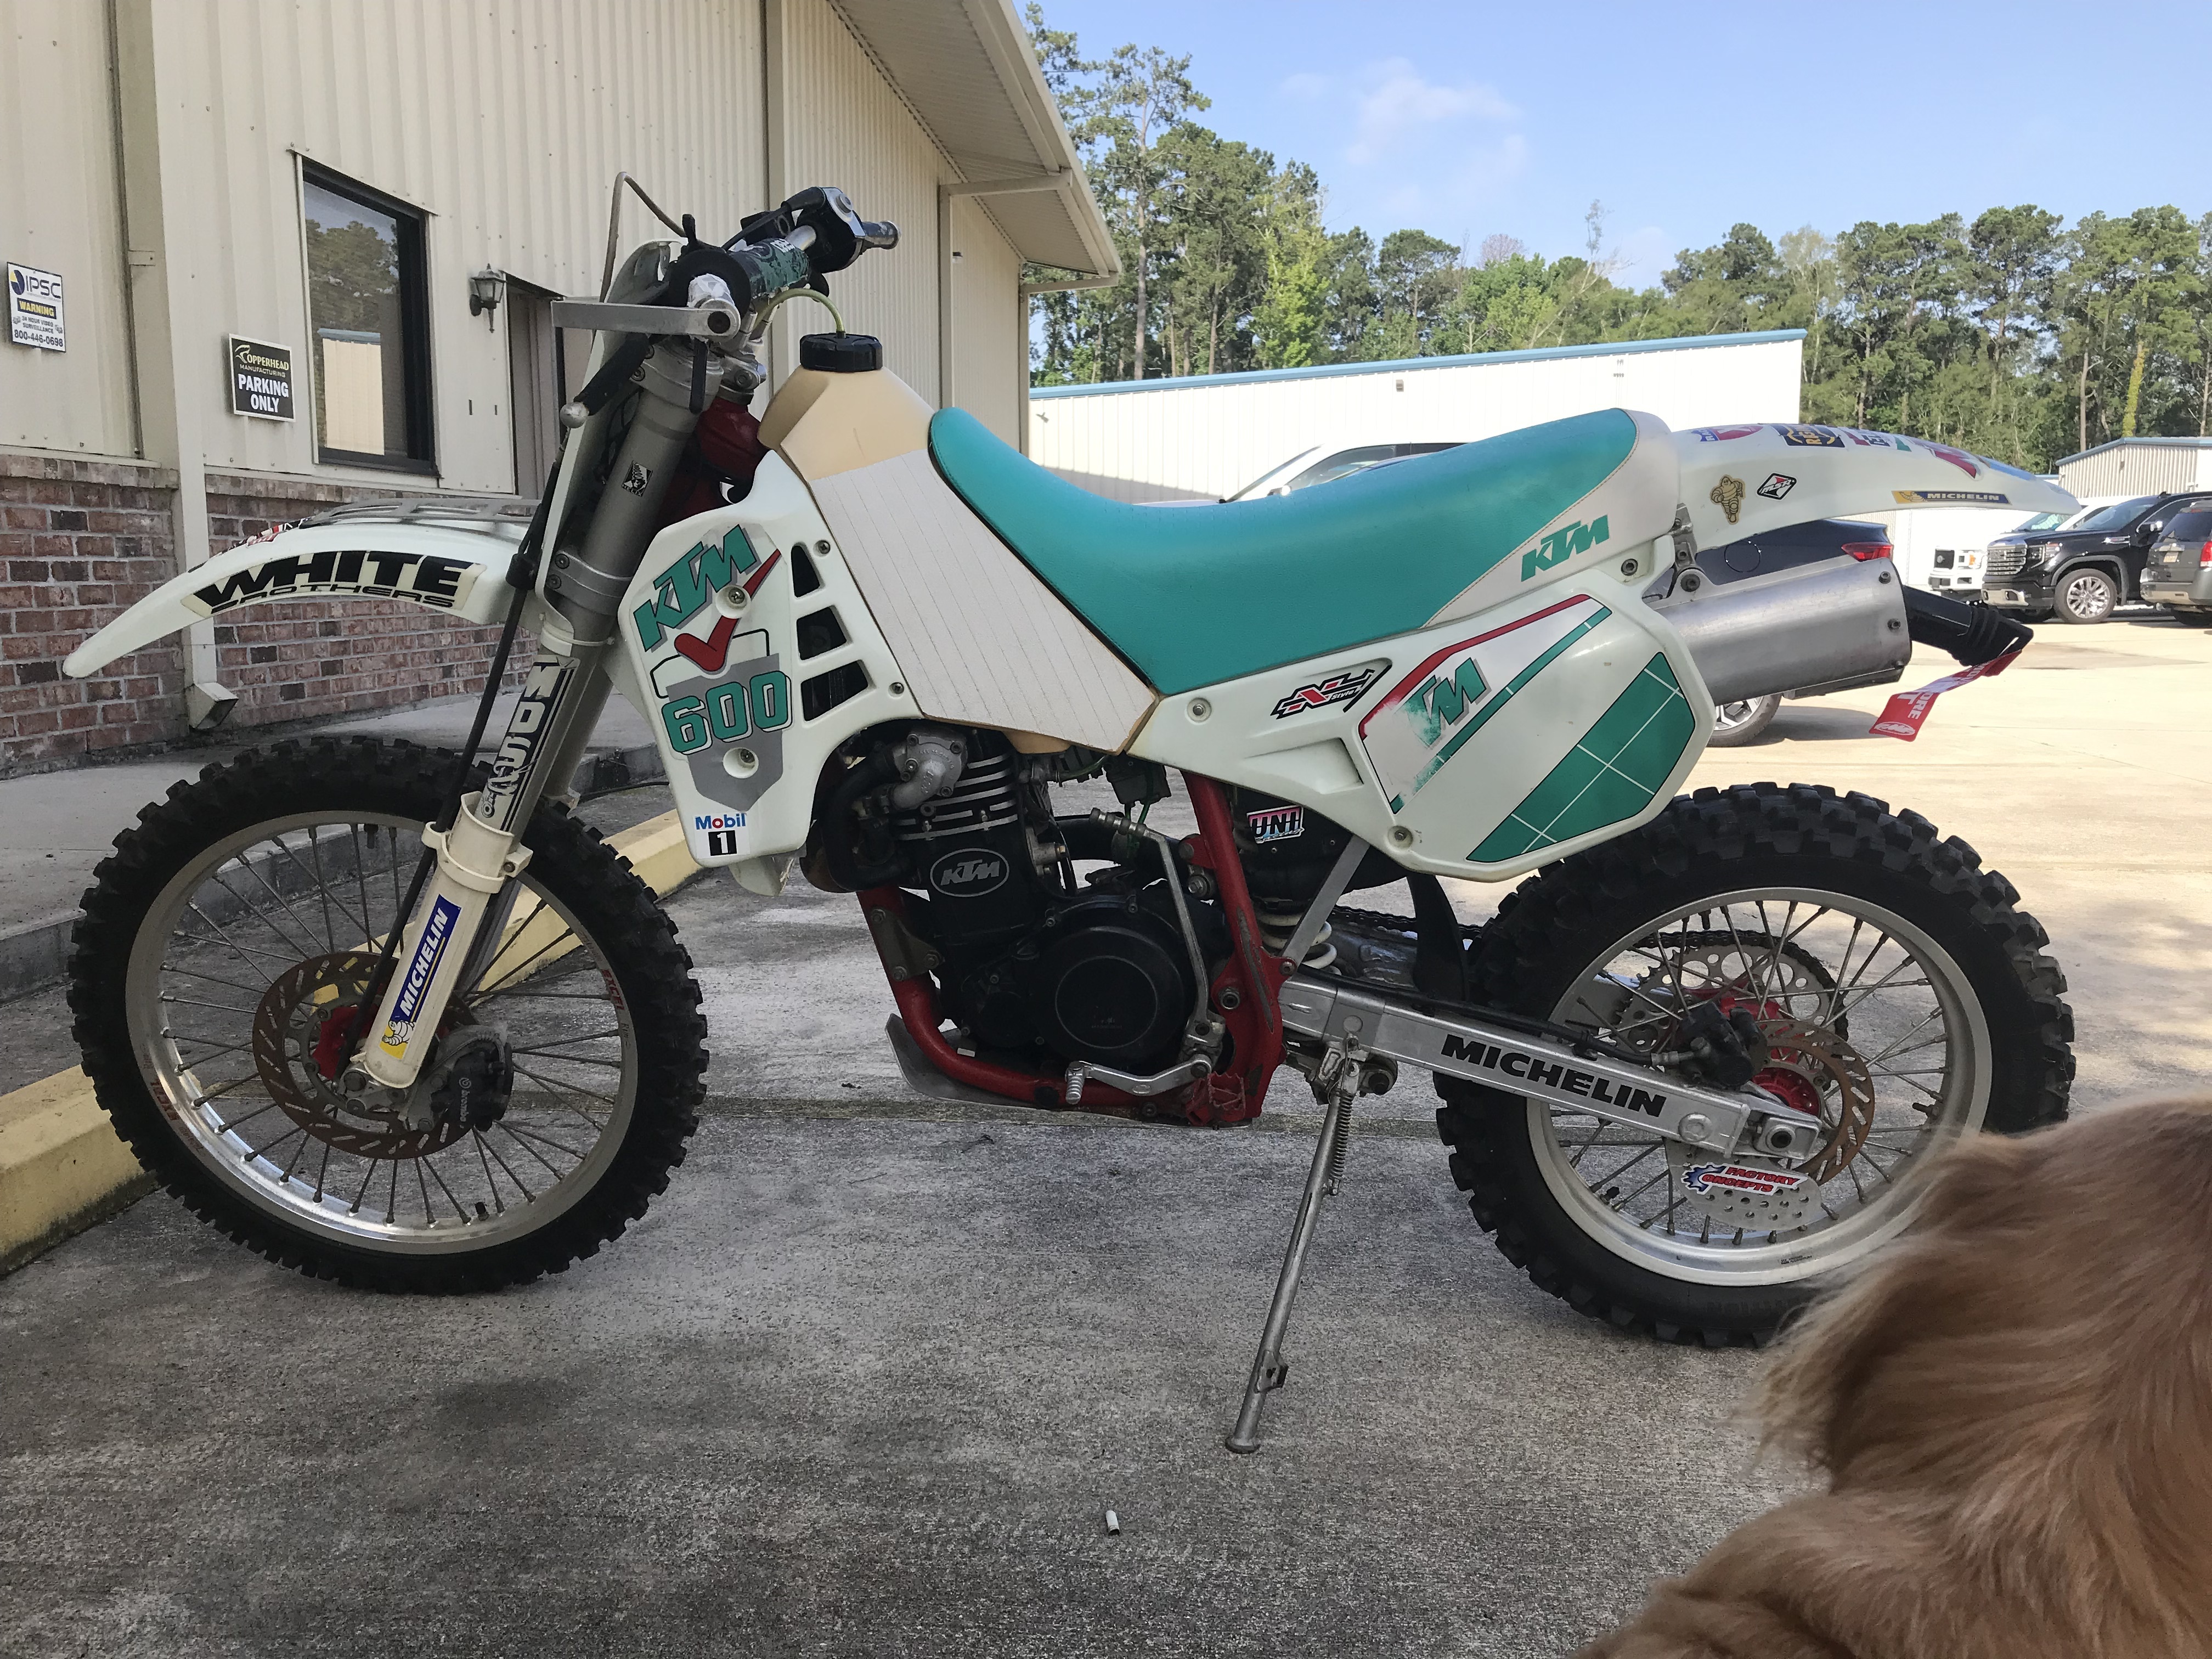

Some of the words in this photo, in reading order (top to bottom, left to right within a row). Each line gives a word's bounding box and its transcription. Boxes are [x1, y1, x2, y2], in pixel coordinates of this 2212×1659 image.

[19, 300, 54, 317] WARNING
[14, 330, 63, 347] 800-446-0698
[22, 323, 54, 334] SURVEILLANCE
[240, 364, 286, 378] MANUFACTURING
[238, 374, 289, 398] PARKING
[250, 394, 279, 413] ONLY
[1521, 514, 1610, 582] KTM
[194, 550, 475, 607] WHITE
[634, 524, 758, 652] KTM
[1331, 690, 1355, 700] Style
[661, 670, 792, 755] 600
[695, 813, 746, 830] Mobil
[1252, 811, 1296, 836] UNI
[717, 832, 729, 854] 1
[940, 859, 1000, 885] KTM
[400, 907, 448, 1017] MICHELIN
[1441, 1034, 1667, 1118] MICHELIN
[1725, 1166, 1801, 1186] FACTORY
